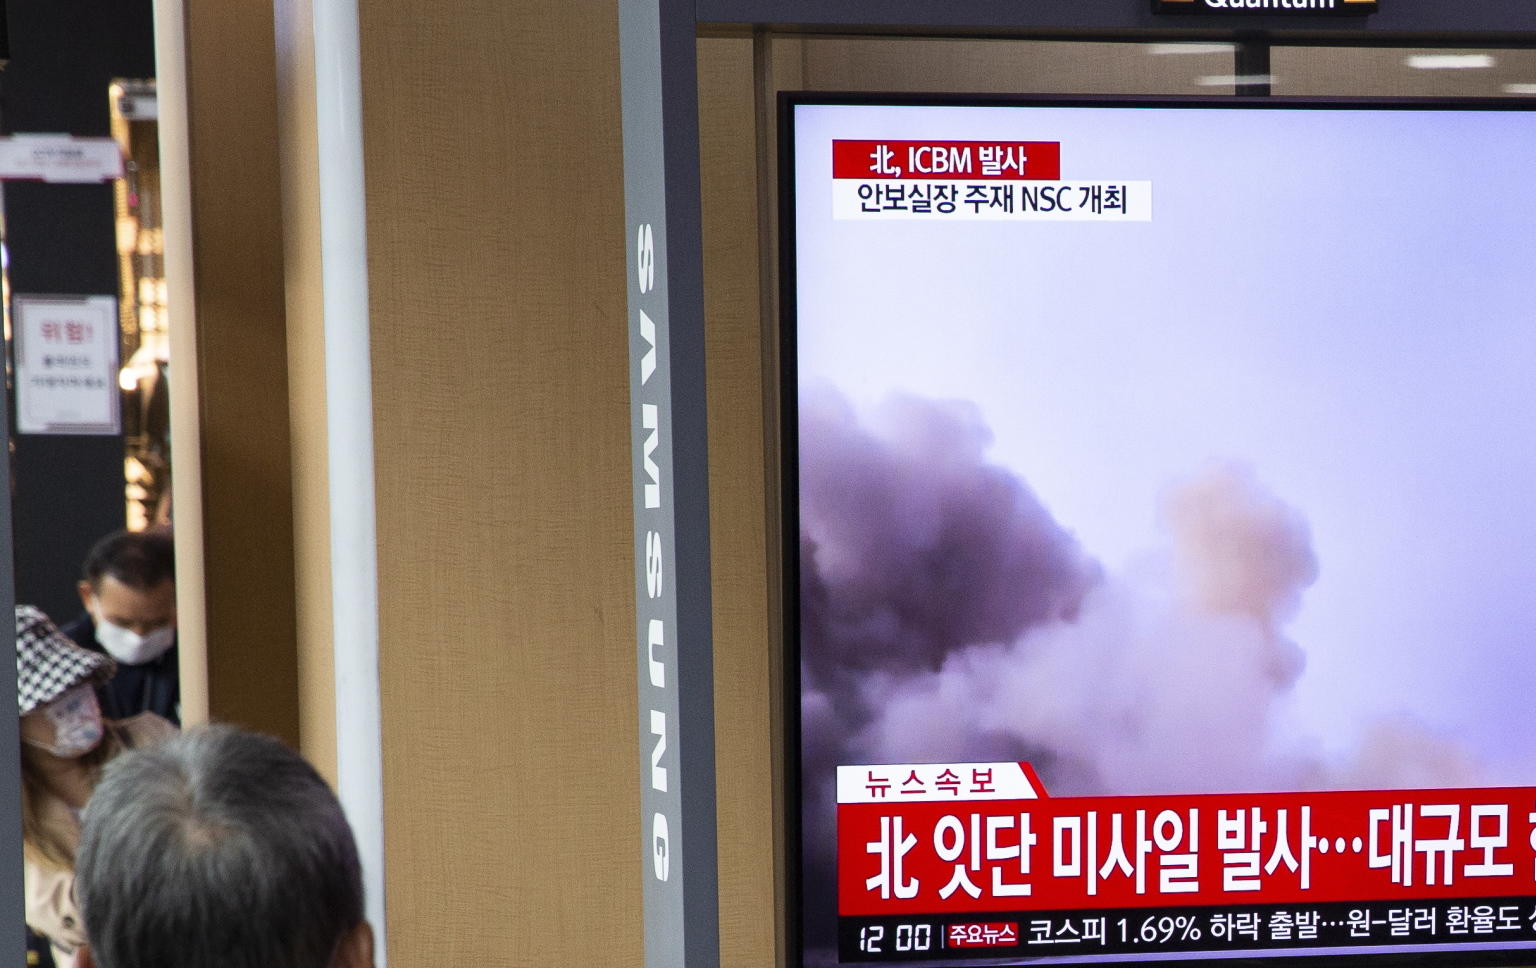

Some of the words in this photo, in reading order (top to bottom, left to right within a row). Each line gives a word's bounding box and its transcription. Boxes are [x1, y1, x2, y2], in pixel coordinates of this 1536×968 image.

[908, 146, 972, 173] ICBM
[978, 145, 1027, 176] 발사
[857, 183, 959, 214] 안보실장
[964, 184, 1014, 214] 주재
[1022, 185, 1072, 212] NSC
[1079, 185, 1127, 215] 개최
[637, 222, 670, 882] SAMSUNG
[864, 767, 996, 798] 뉴스속보
[865, 815, 919, 900] 北
[933, 812, 1037, 900] 잇단
[1053, 808, 1199, 896] 미사일
[859, 925, 884, 953] 12
[895, 924, 931, 952] 00
[949, 924, 1016, 946] 주요뉴스
[1027, 916, 1106, 946] 코스피
[1117, 915, 1202, 944] 1.69%
[1209, 912, 1262, 942] 하락
[1445, 905, 1522, 934] 환율도
